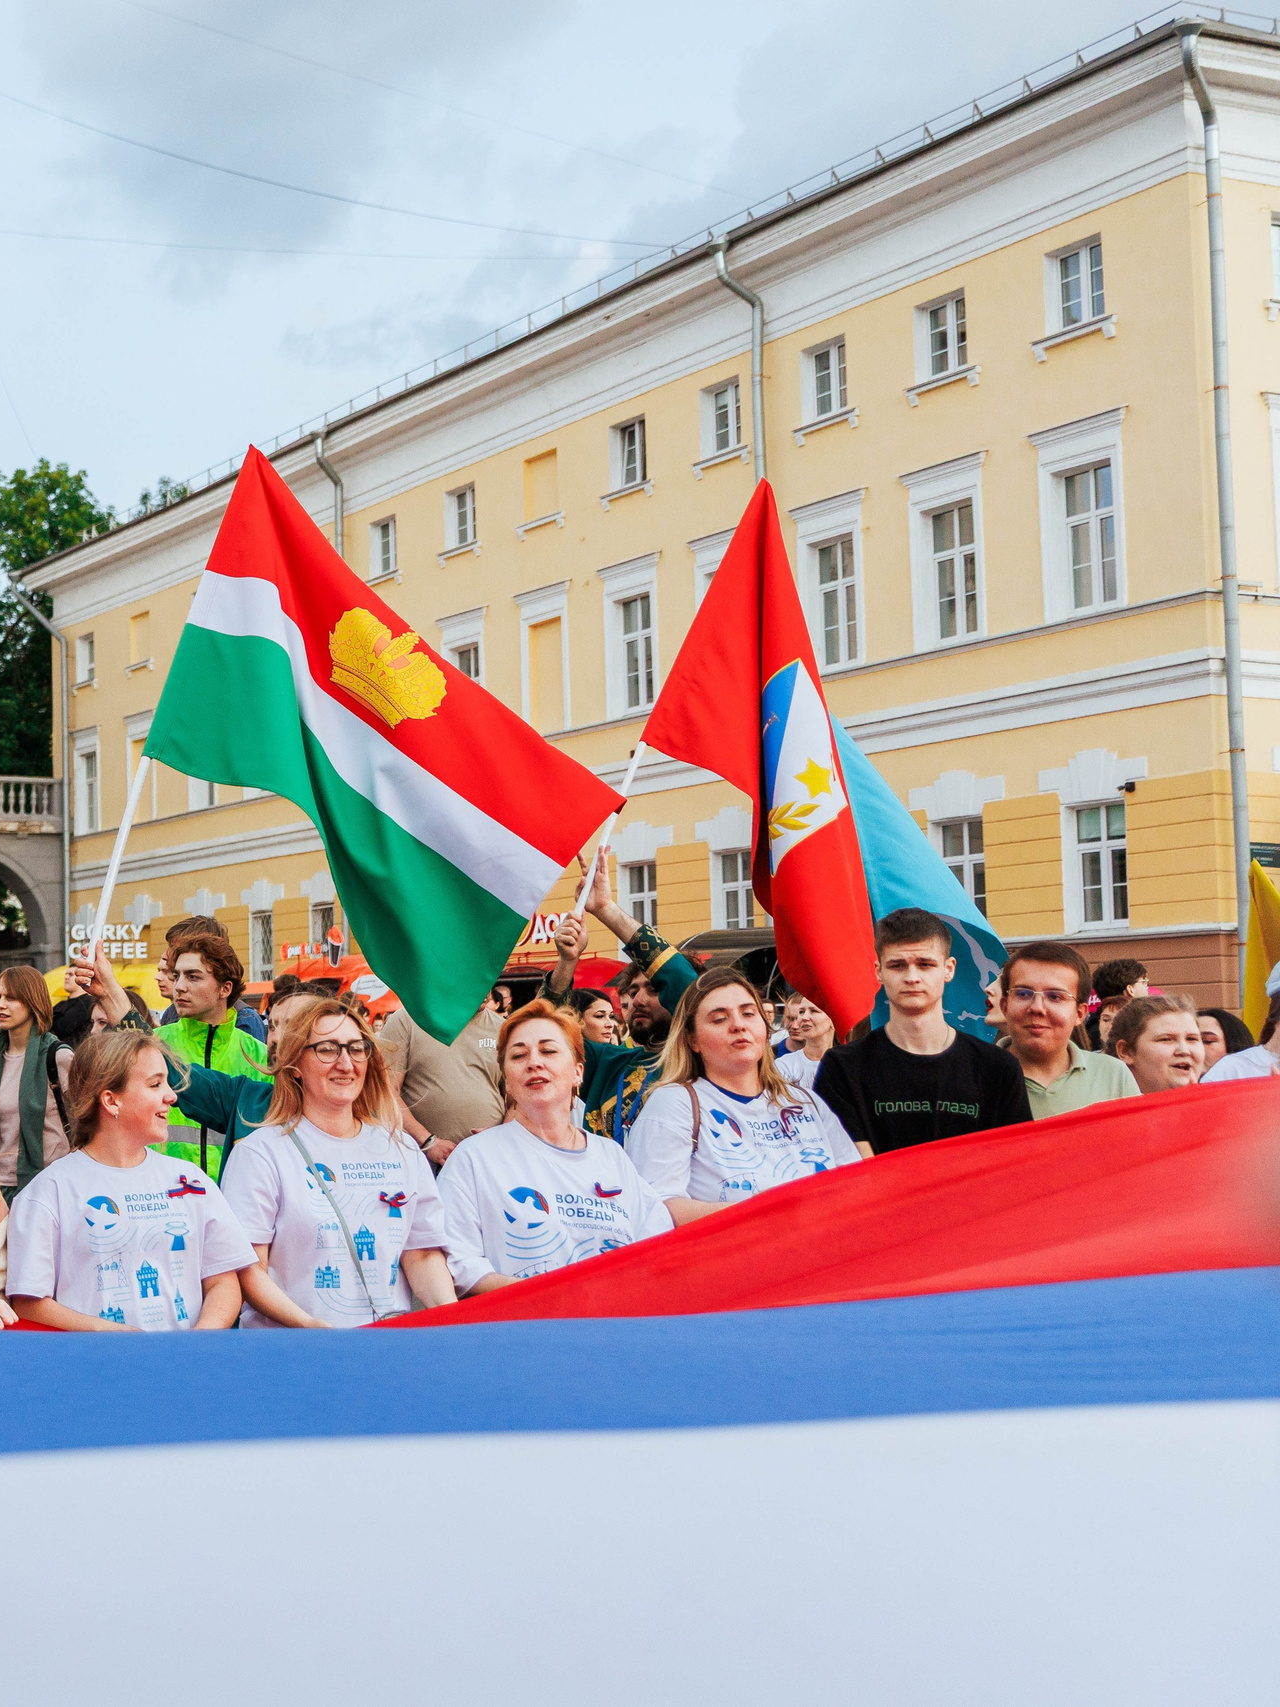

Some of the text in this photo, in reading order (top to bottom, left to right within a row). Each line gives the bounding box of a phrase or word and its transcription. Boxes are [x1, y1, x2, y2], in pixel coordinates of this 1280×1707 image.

[341, 1161, 402, 1171] ВОЛОНТЁРЫ
[343, 1171, 385, 1180] ПОБЕДЫ
[127, 1202, 170, 1213] ПОБЕДЫ
[557, 1206, 615, 1222] ПОБЕДЫ
